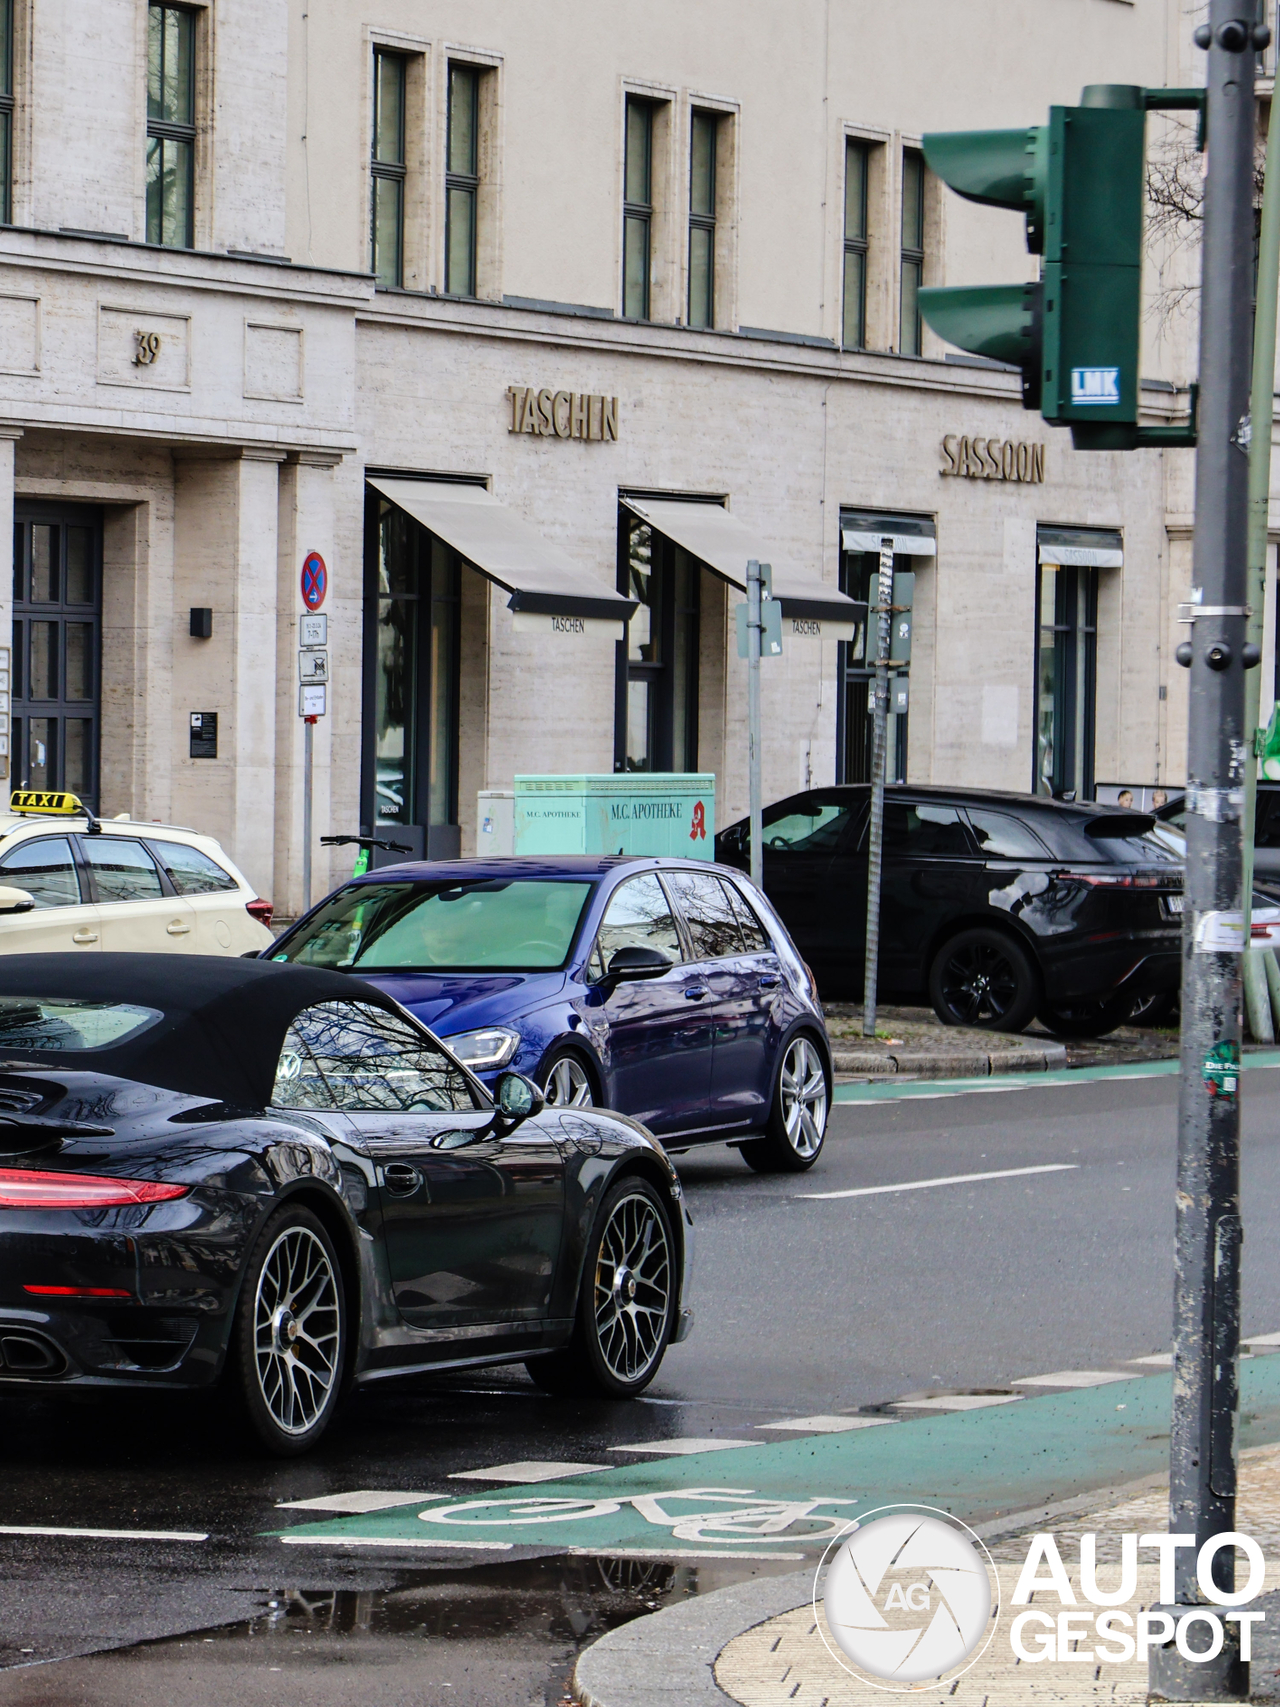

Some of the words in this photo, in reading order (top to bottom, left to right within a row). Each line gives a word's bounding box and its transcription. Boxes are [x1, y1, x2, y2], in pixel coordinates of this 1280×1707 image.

[136, 330, 162, 364] 39
[1072, 371, 1119, 396] LMK
[507, 385, 619, 441] TASCHEN
[939, 434, 1045, 484] SASSOON
[1064, 548, 1098, 564] SASSOON
[551, 616, 585, 633] TASCHEN
[792, 619, 822, 635] TASCHEN
[18, 793, 59, 807] TAXI
[381, 805, 400, 814] TASCHEN
[542, 811, 582, 819] APOTHEKE
[611, 803, 630, 820] M.C.
[631, 802, 683, 820] APOTHEKE
